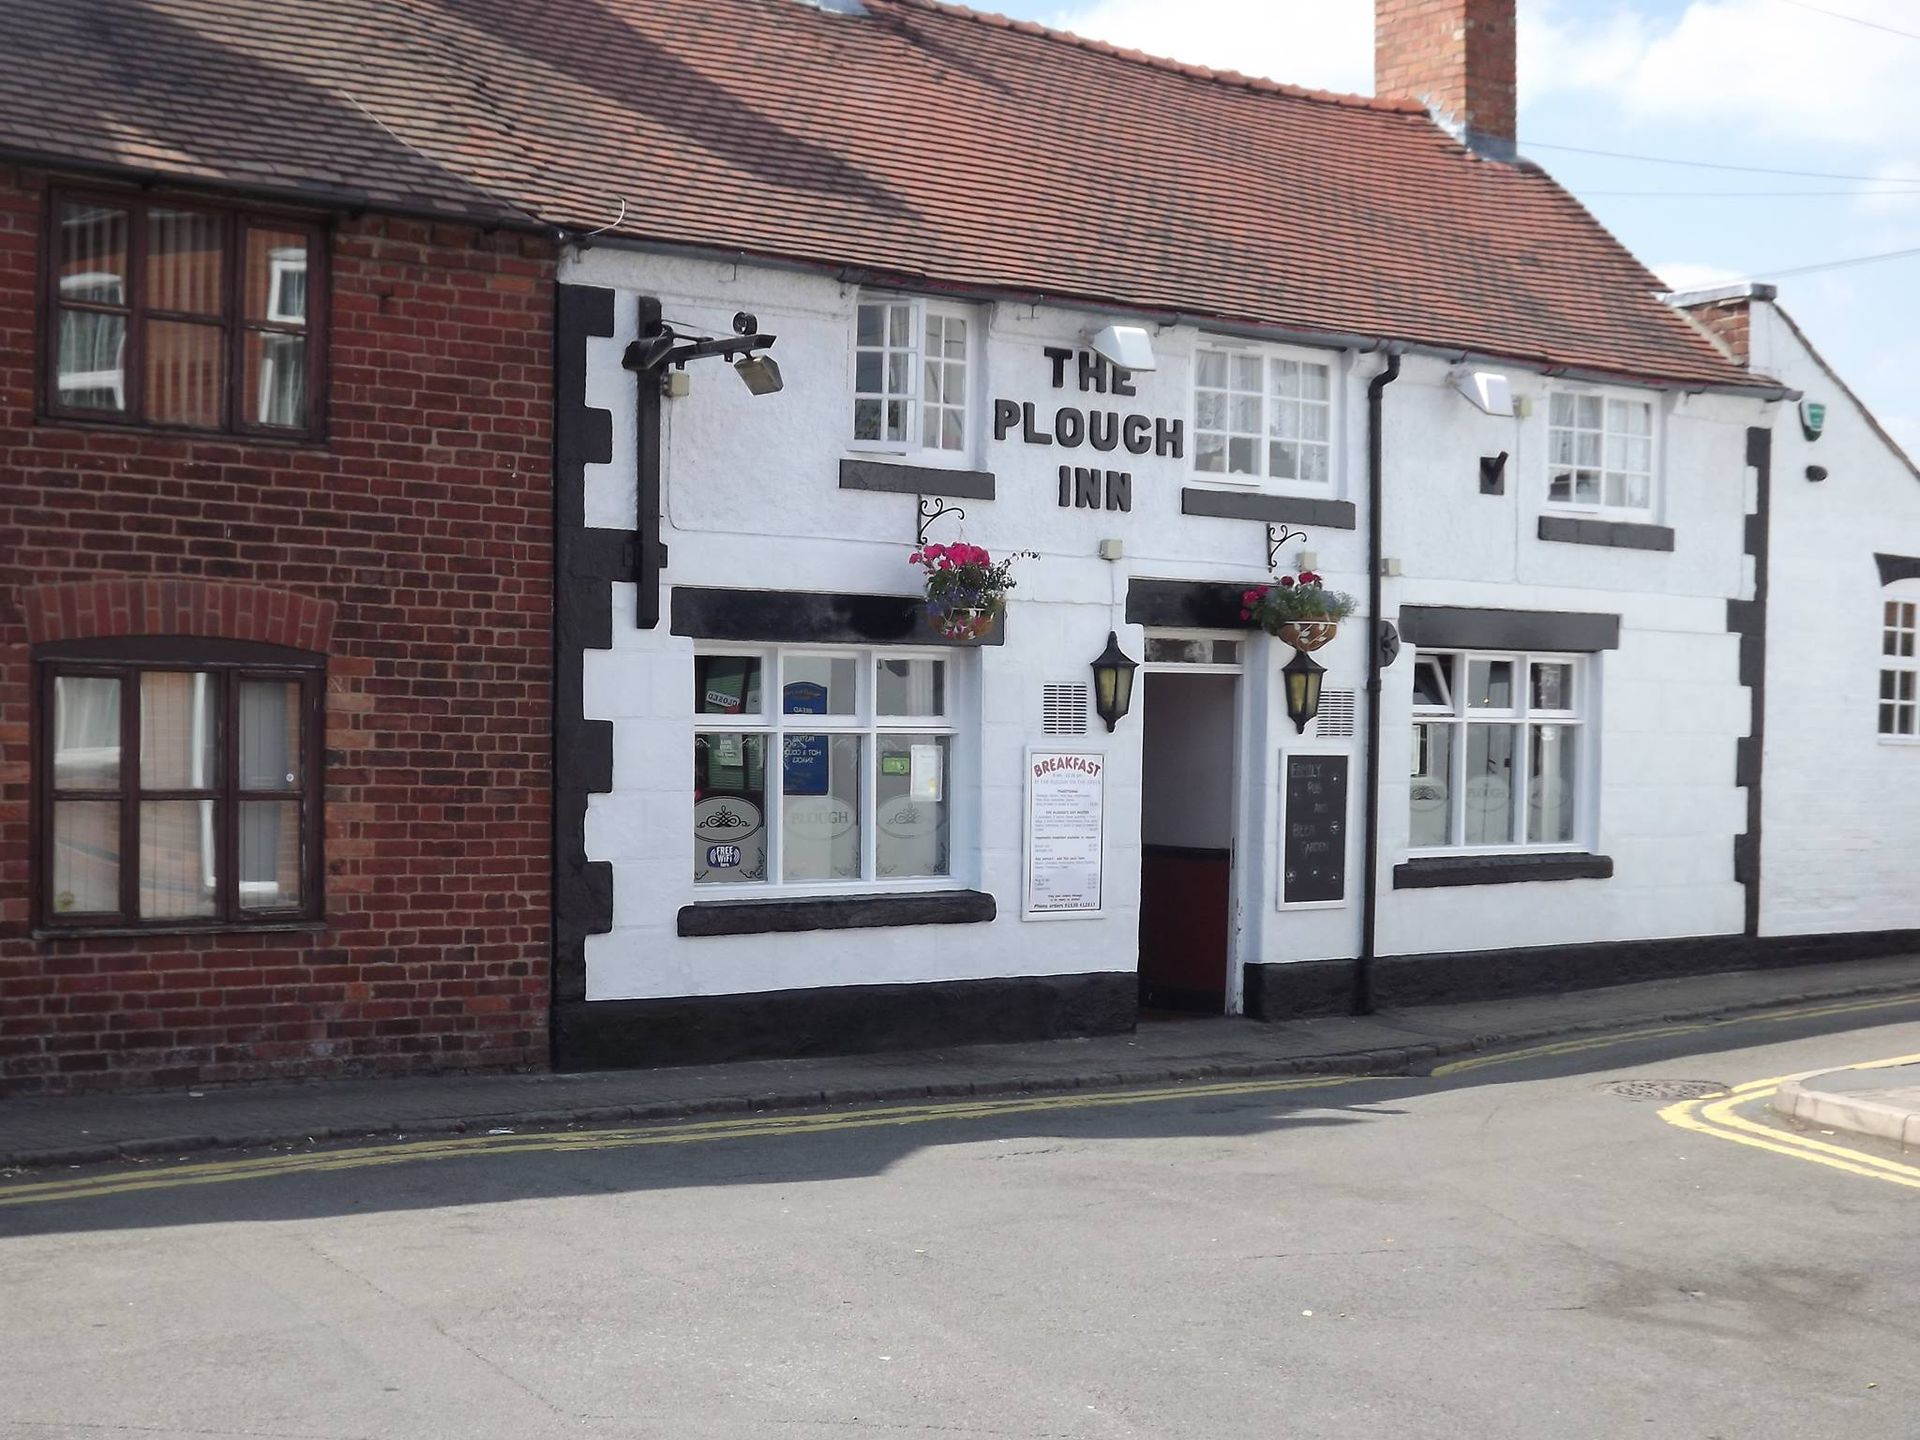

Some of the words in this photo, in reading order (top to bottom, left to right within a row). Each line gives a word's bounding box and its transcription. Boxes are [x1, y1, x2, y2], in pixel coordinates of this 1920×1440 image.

[1044, 346, 1137, 397] THE
[994, 398, 1184, 459] PLOUGH
[1058, 465, 1132, 513] INN
[1033, 756, 1101, 778] BREAKFAST
[716, 846, 733, 855] FREE
